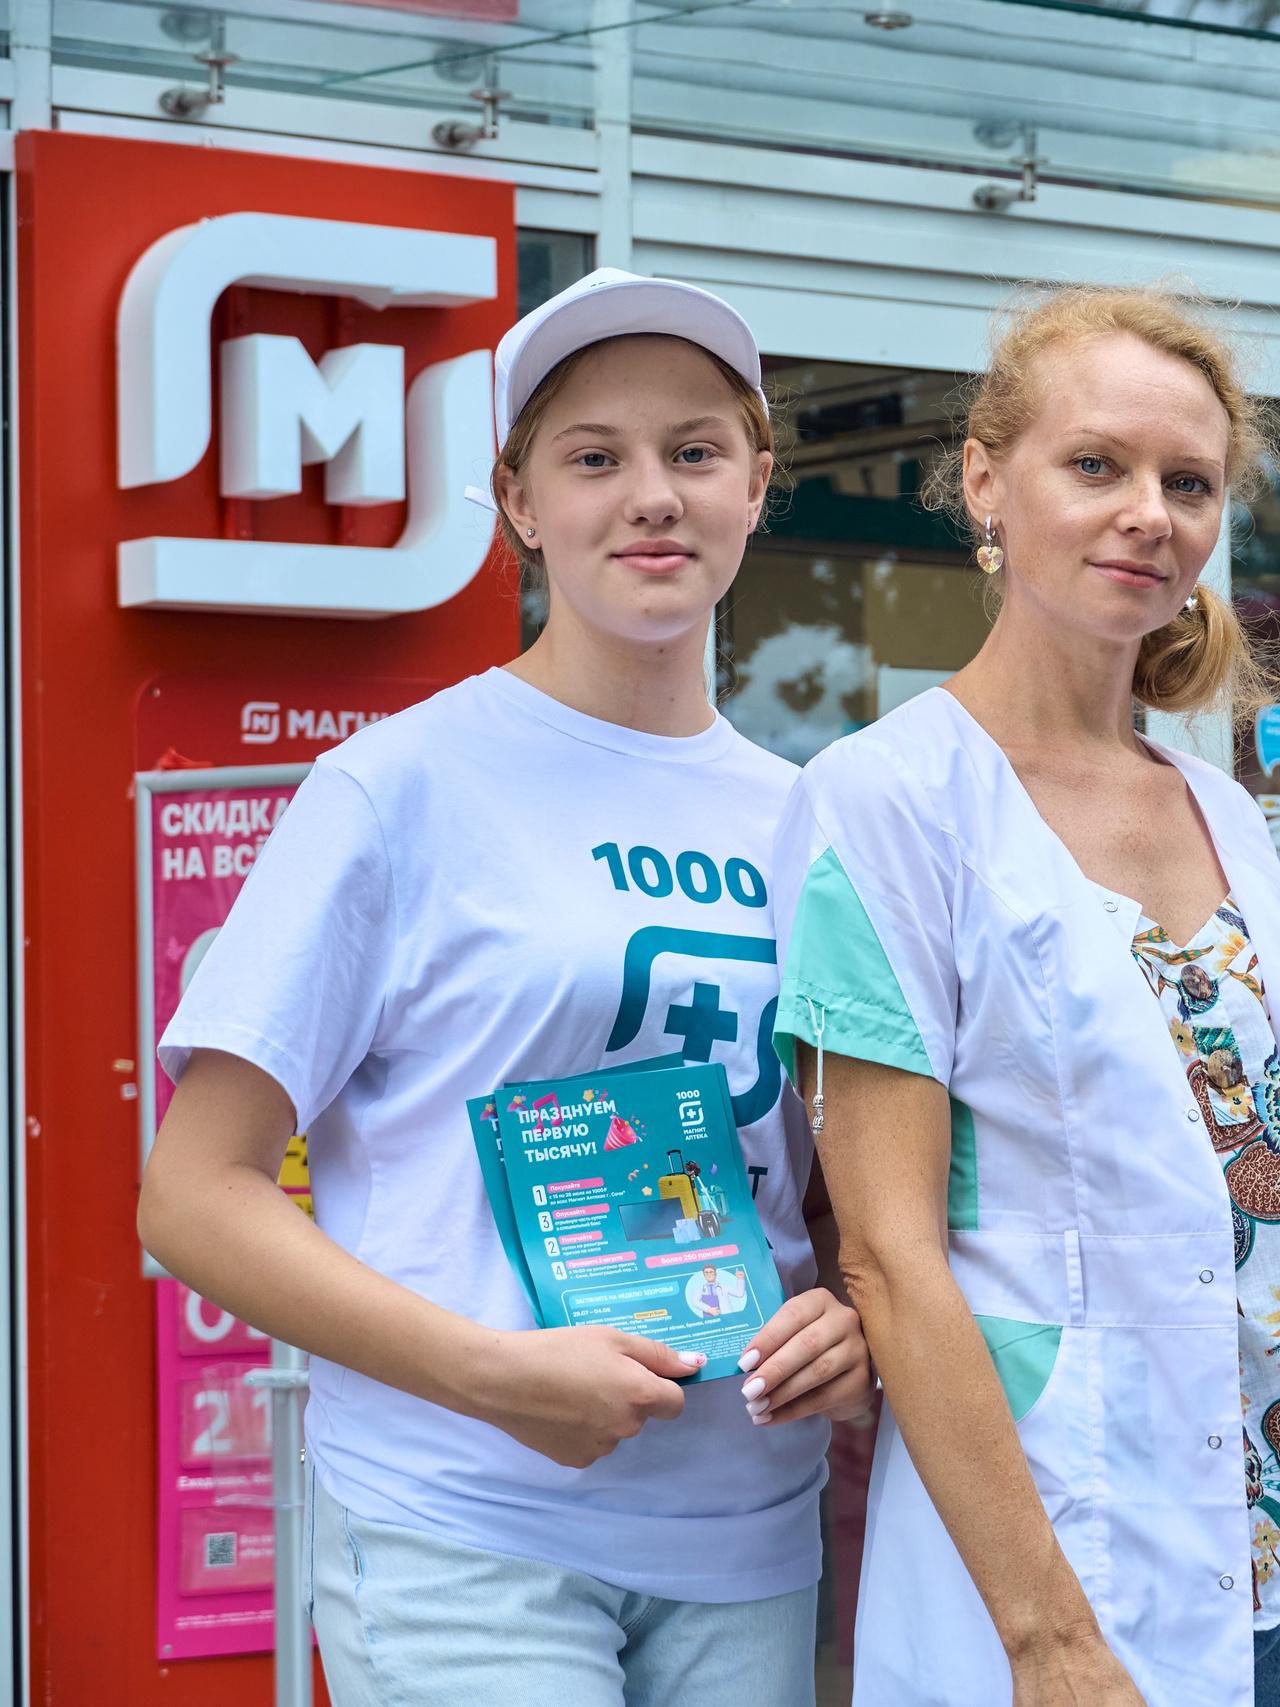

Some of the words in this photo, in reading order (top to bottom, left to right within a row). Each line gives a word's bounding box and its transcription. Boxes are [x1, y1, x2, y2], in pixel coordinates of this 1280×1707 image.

[288, 709, 388, 740] МАГН
[163, 847, 206, 881] НА
[591, 842, 768, 908] 1000
[676, 1090, 700, 1100] 1000
[519, 1100, 616, 1124] ПРАЗДНУЕМ
[522, 1123, 588, 1143] ПЕРВУЮ
[524, 1142, 597, 1162] ТЫСЯЧУ!
[550, 1183, 580, 1191] Покупайте
[536, 1190, 543, 1202] 1
[556, 1209, 586, 1217] Опускайте
[542, 1216, 550, 1228] 3
[548, 1241, 557, 1253] 2
[698, 1250, 723, 1259] призов
[556, 1266, 563, 1276] 4
